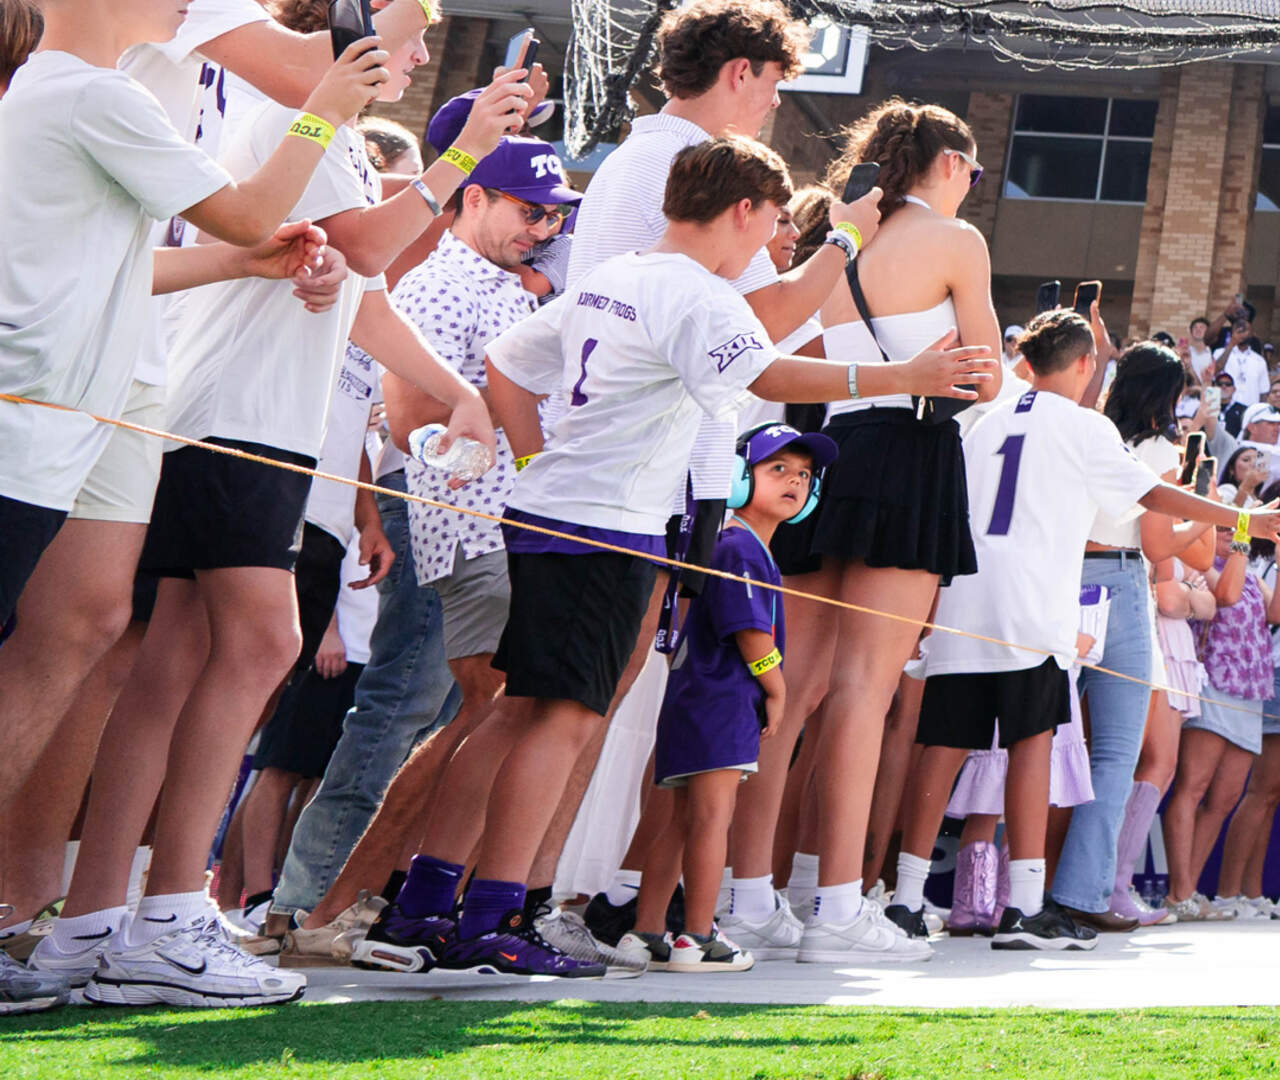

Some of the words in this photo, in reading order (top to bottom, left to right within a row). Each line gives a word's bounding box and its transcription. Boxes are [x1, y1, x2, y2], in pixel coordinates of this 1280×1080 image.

[290, 122, 322, 137] TCU
[530, 154, 562, 179] TC
[608, 299, 637, 322] FROGS
[984, 432, 1027, 537] 1
[754, 654, 776, 671] TCU
